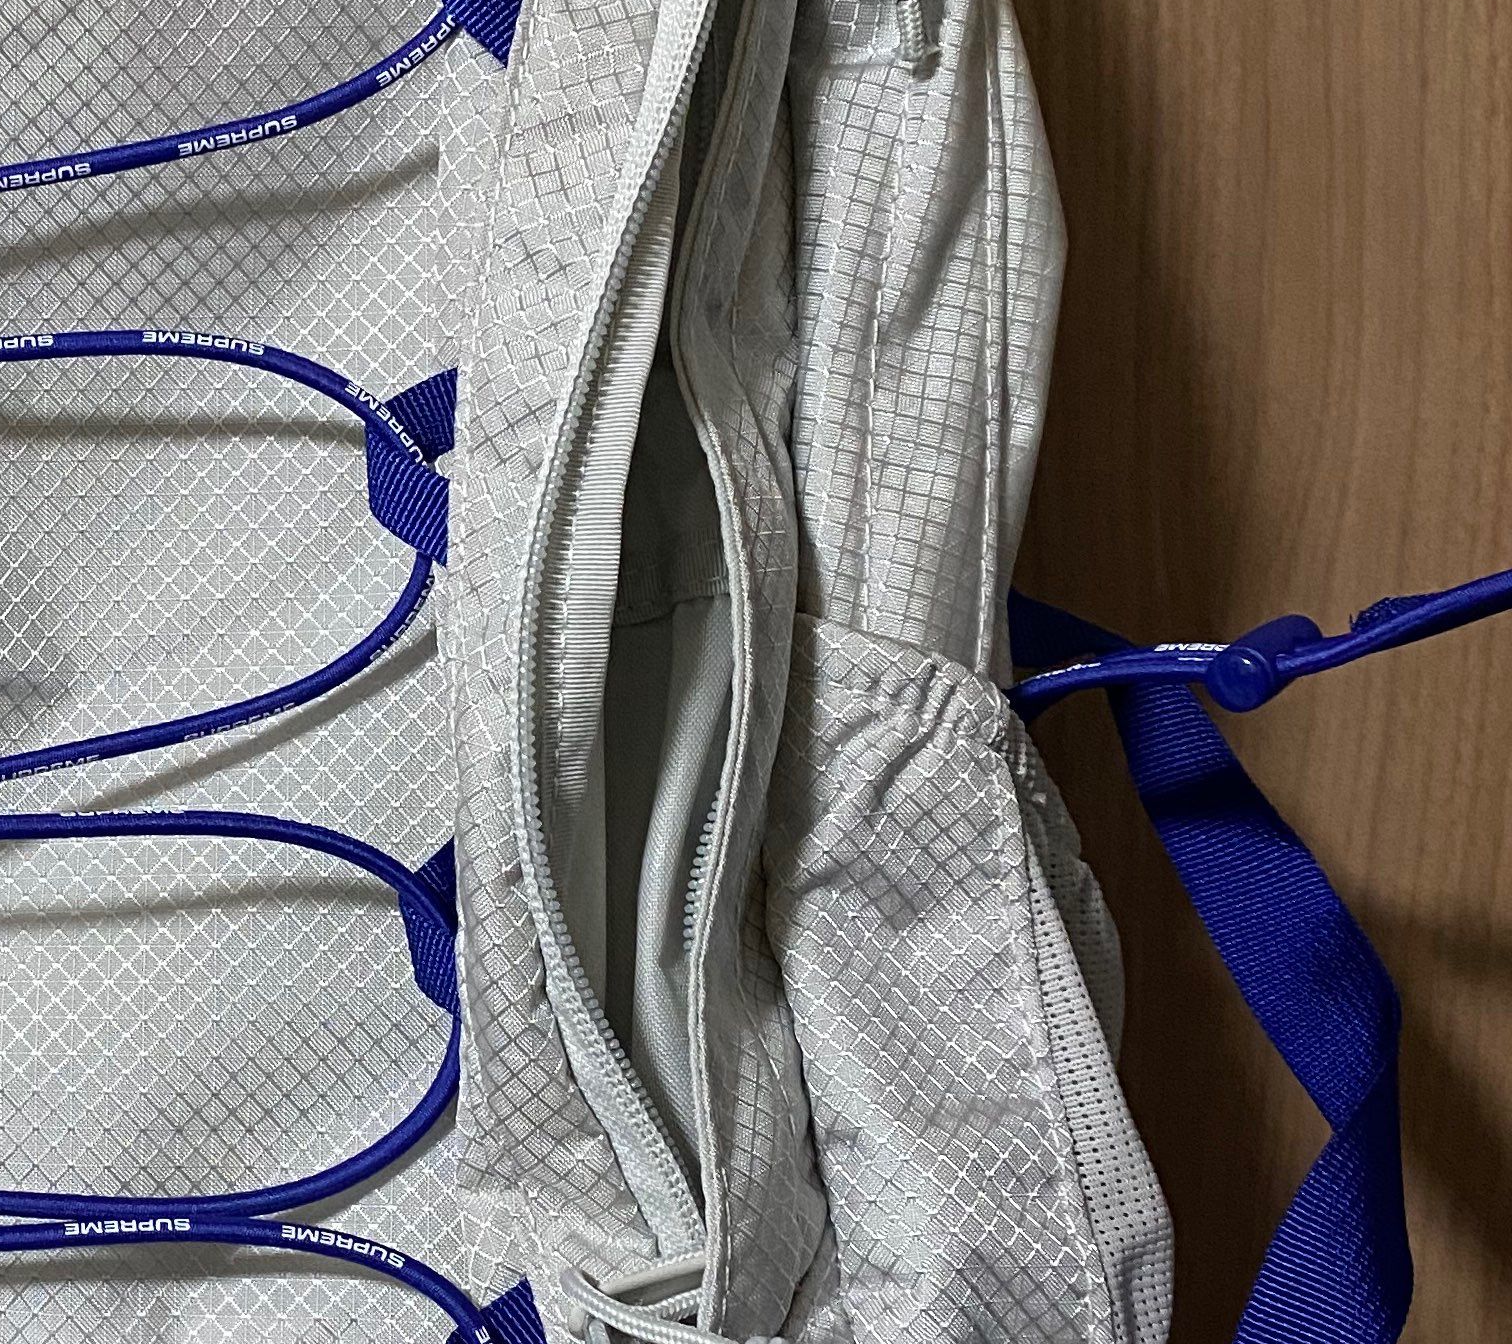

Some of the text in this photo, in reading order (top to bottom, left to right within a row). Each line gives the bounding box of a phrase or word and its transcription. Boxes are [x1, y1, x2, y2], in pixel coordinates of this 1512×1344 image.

[375, 14, 457, 87] UPREME
[177, 114, 298, 158] SUPREME
[141, 329, 265, 356] SUPREME
[344, 381, 427, 467] UPREME
[64, 1217, 192, 1237] SUPREME
[280, 1224, 406, 1268] SUPREME
